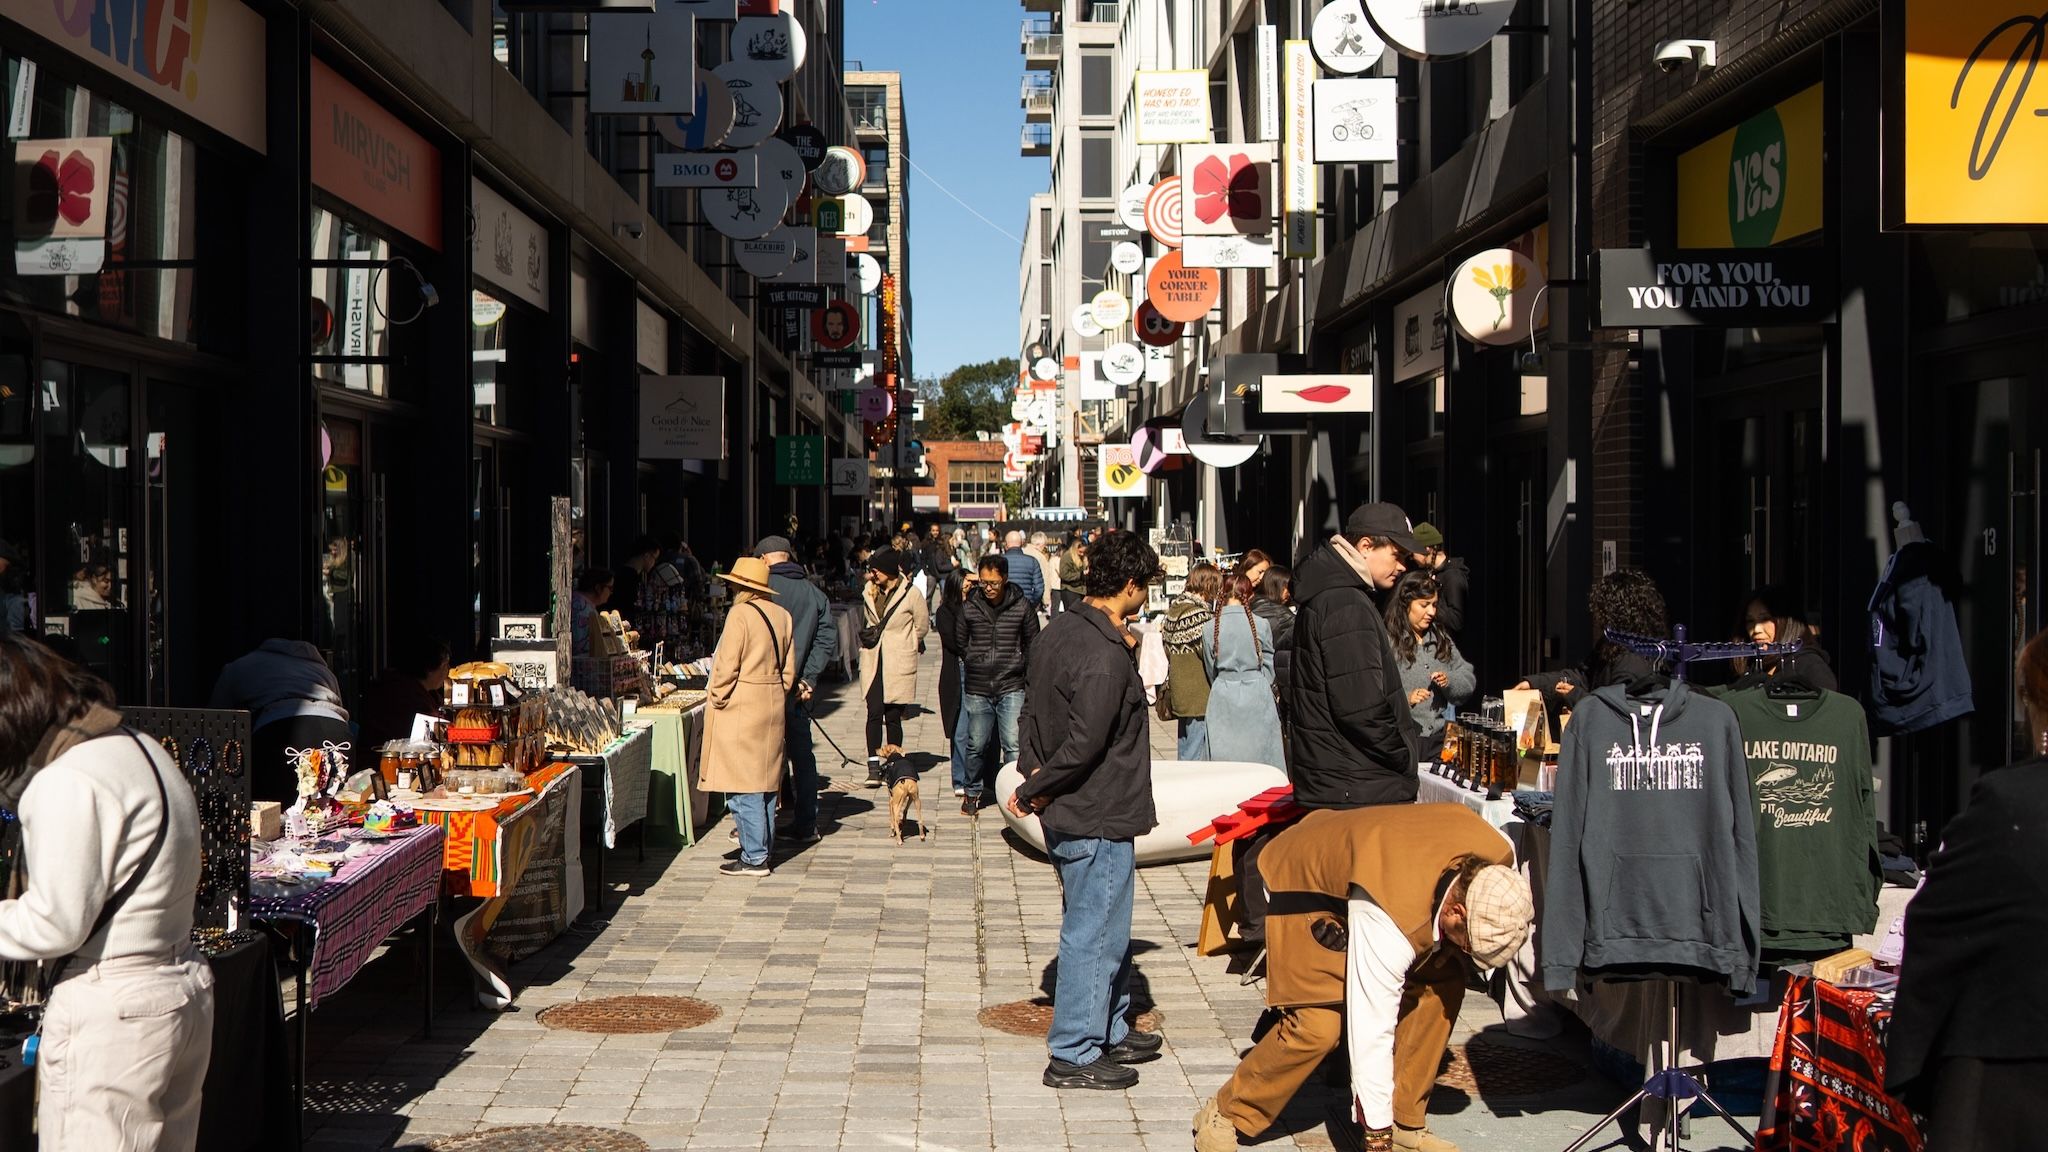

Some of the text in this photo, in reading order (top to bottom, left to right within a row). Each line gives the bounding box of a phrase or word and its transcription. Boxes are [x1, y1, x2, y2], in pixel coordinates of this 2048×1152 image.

[1143, 98, 1161, 108] HAS
[333, 103, 411, 192] MIRVISH
[795, 135, 813, 147] THE
[672, 163, 711, 176] BMO
[744, 242, 786, 253] BLACKBIRD
[1168, 270, 1200, 279] YOUR
[1656, 262, 1781, 287] FOR YOU,
[1159, 281, 1208, 291] CORNER
[769, 290, 819, 303] THE KITCHEN
[1166, 292, 1203, 302] TABLE
[1627, 284, 1812, 310] YOU AND YOU
[651, 415, 679, 426] Good
[691, 415, 711, 426] Nice
[1982, 527, 1997, 557] 13
[80, 536, 90, 564] 15
[1744, 740, 1838, 764] LAKE ONTARIO
[1774, 806, 1834, 829] Beautiful
